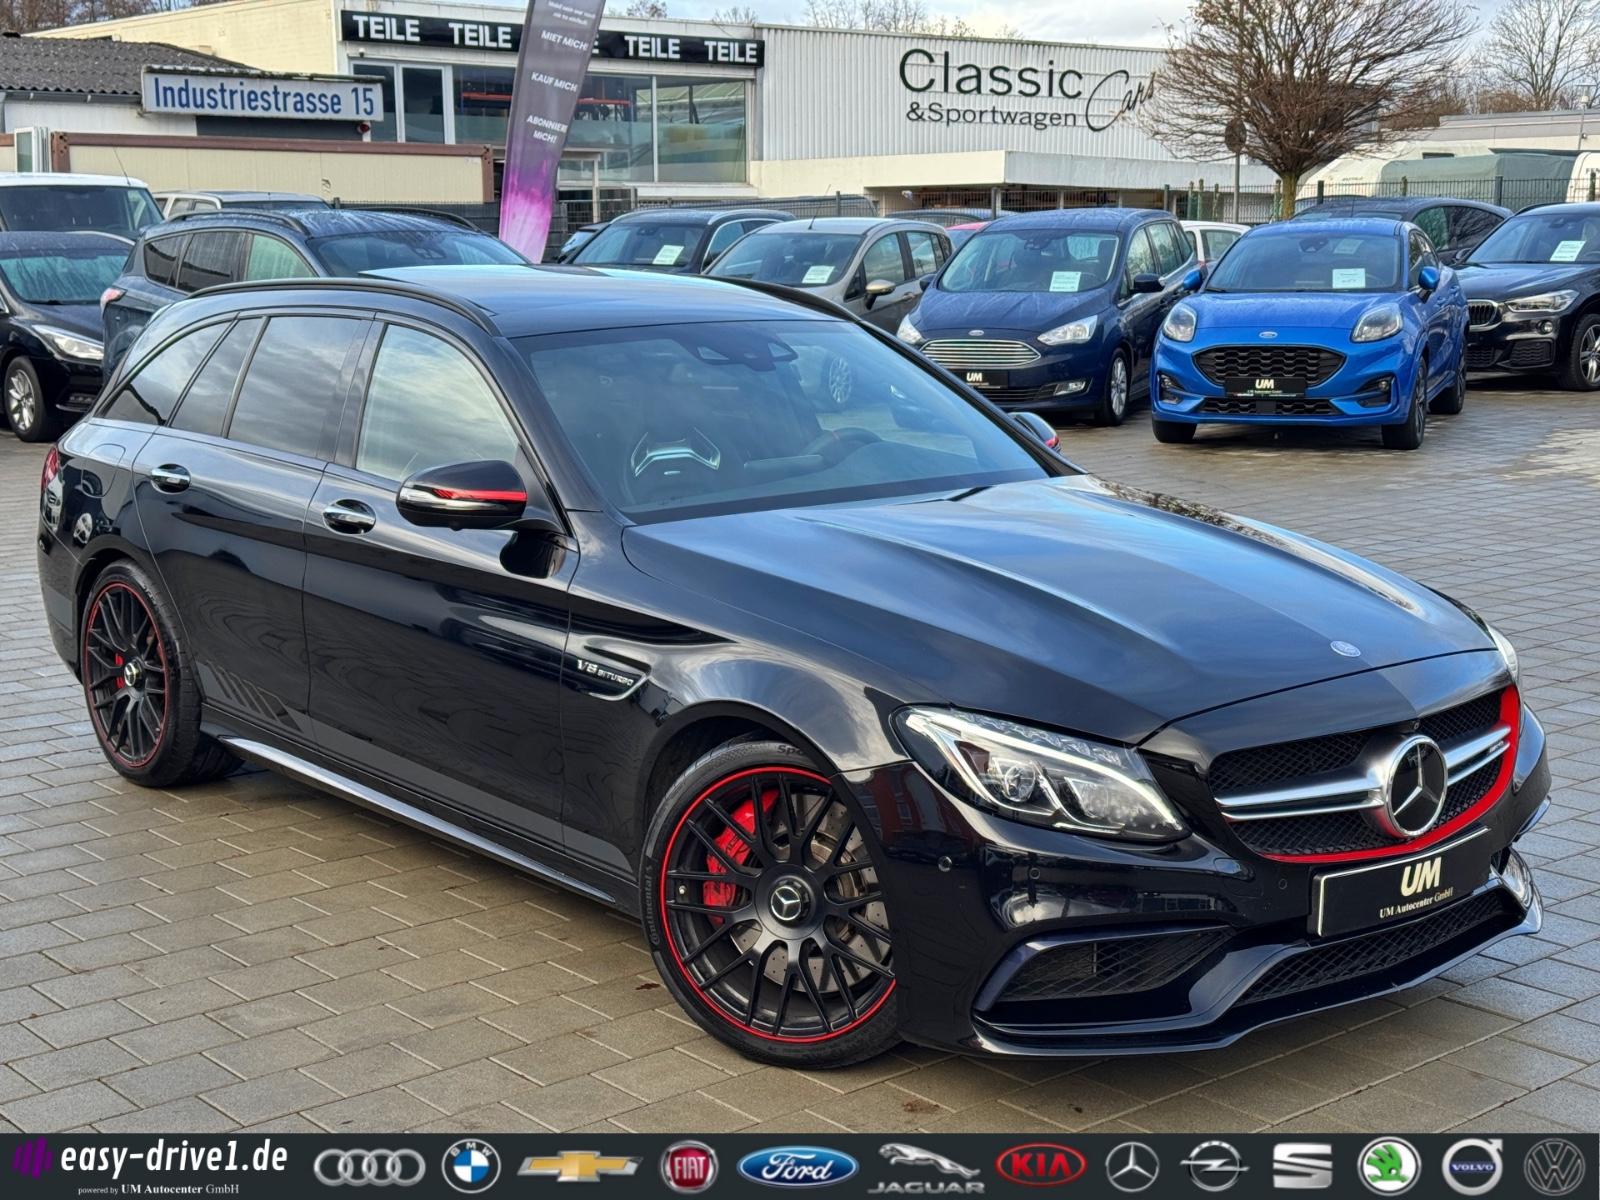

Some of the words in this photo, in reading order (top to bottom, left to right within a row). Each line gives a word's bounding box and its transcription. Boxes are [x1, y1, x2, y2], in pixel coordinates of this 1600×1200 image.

[352, 15, 421, 42] TEILE
[448, 22, 512, 48] TEILE
[624, 35, 680, 59] TEILE
[704, 40, 758, 63] TEILE
[541, 30, 563, 43] MIET
[531, 71, 554, 86] KAUF
[899, 48, 1083, 99] Classic
[153, 77, 342, 115] Industriestrasse
[350, 87, 374, 116] 15
[906, 101, 1077, 131] &Sportwagen
[966, 372, 983, 382] UM
[1255, 378, 1275, 389] UM
[577, 659, 599, 674] V8
[598, 668, 635, 687] BITURBO
[777, 744, 807, 757] Spo
[1400, 856, 1442, 897] UM
[645, 874, 660, 945] Continental
[1379, 905, 1394, 919] UM
[1395, 896, 1434, 915] Autocenter
[1434, 886, 1454, 902] GmbH
